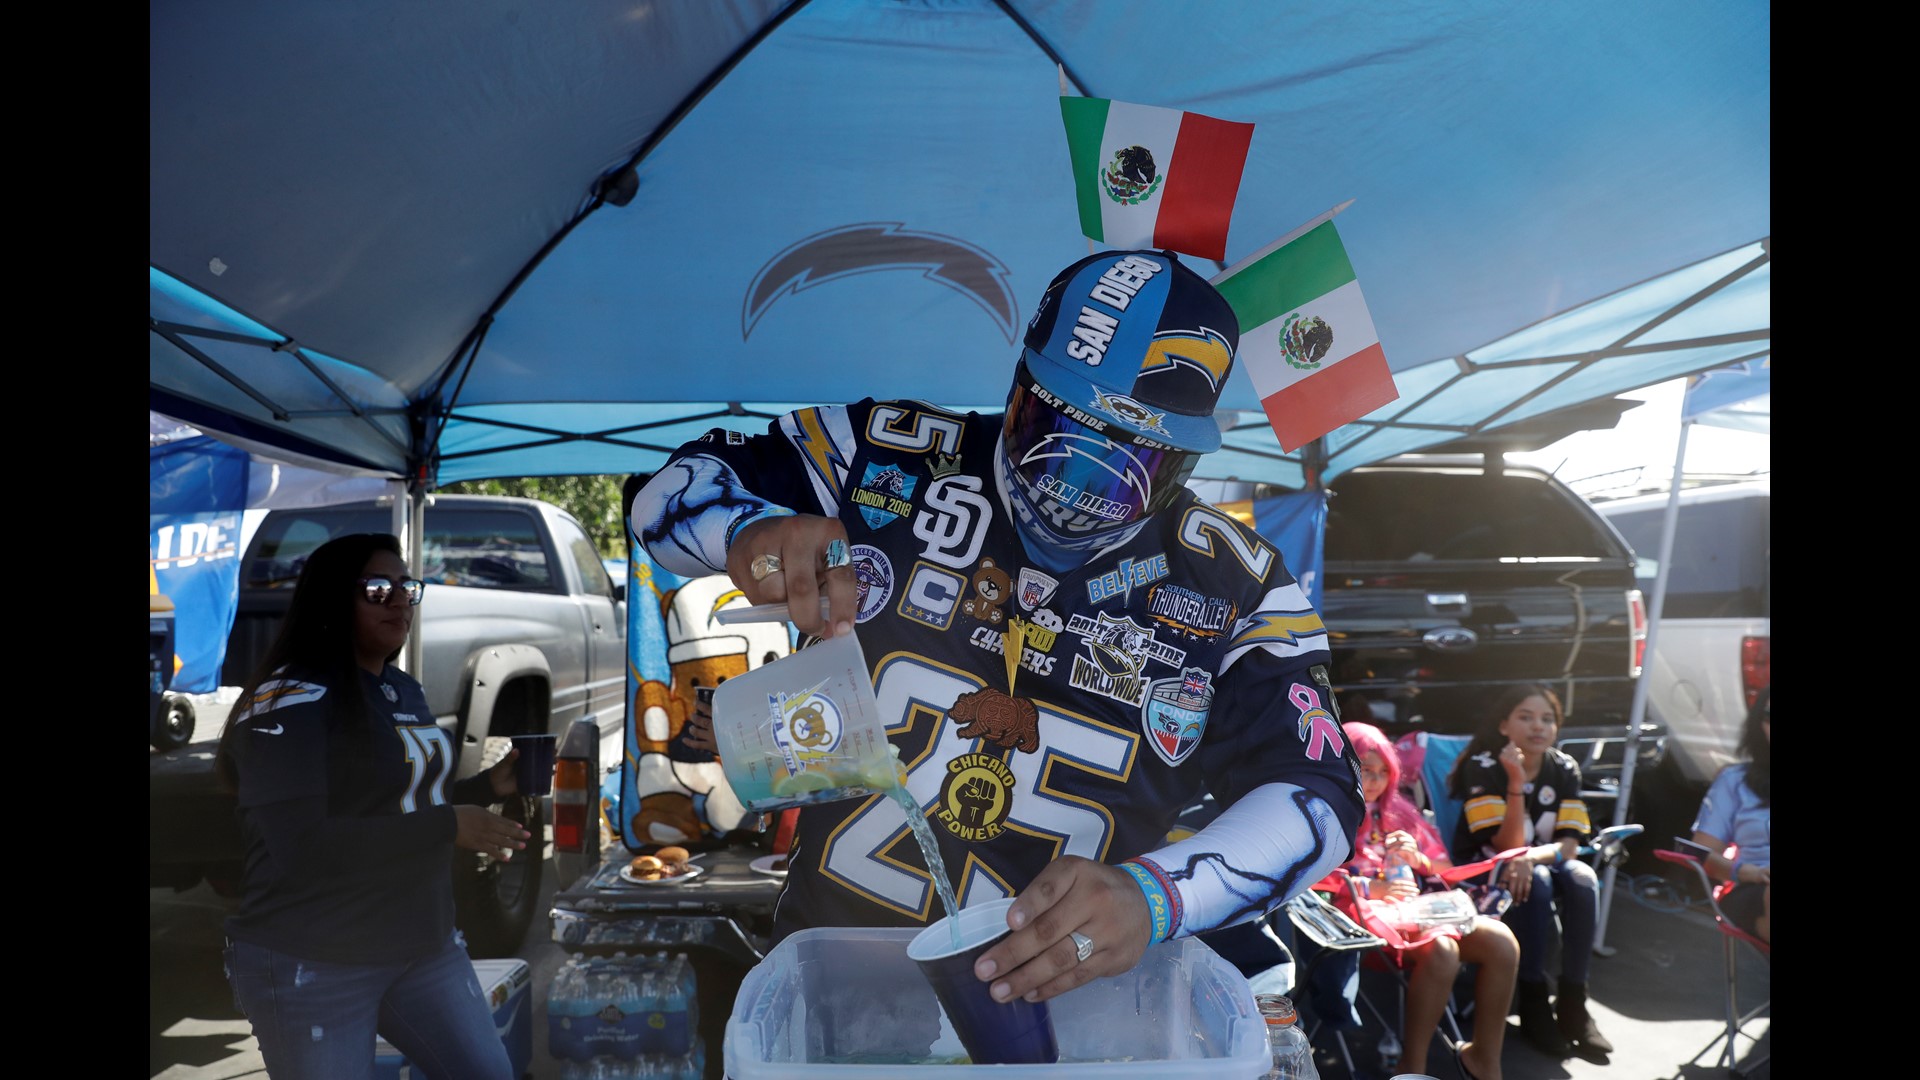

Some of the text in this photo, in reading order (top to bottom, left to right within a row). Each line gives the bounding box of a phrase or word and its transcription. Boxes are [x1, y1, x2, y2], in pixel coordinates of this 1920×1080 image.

[1089, 255, 1164, 313] DIEGO
[1066, 306, 1120, 367] SAN
[1030, 383, 1064, 409] BOLT
[1063, 405, 1107, 432] PRIDE
[850, 487, 887, 508] LONDON
[886, 498, 912, 518] 2018
[1037, 474, 1078, 503] SAN
[1073, 492, 1132, 521] DIEGO
[909, 567, 959, 615] C
[1022, 572, 1054, 590] EQUIPMENT
[1024, 591, 1039, 606] NFL
[1165, 584, 1206, 604] SOUTHERN
[1069, 617, 1108, 637] BOLT
[1140, 638, 1184, 664] PRIDE
[1072, 657, 1148, 704] WORLDWIDE
[395, 725, 453, 814] 17
[949, 754, 1015, 787] CHICANO
[938, 809, 1002, 840] POWER
[1121, 862, 1166, 940] BOLT PRIDE
